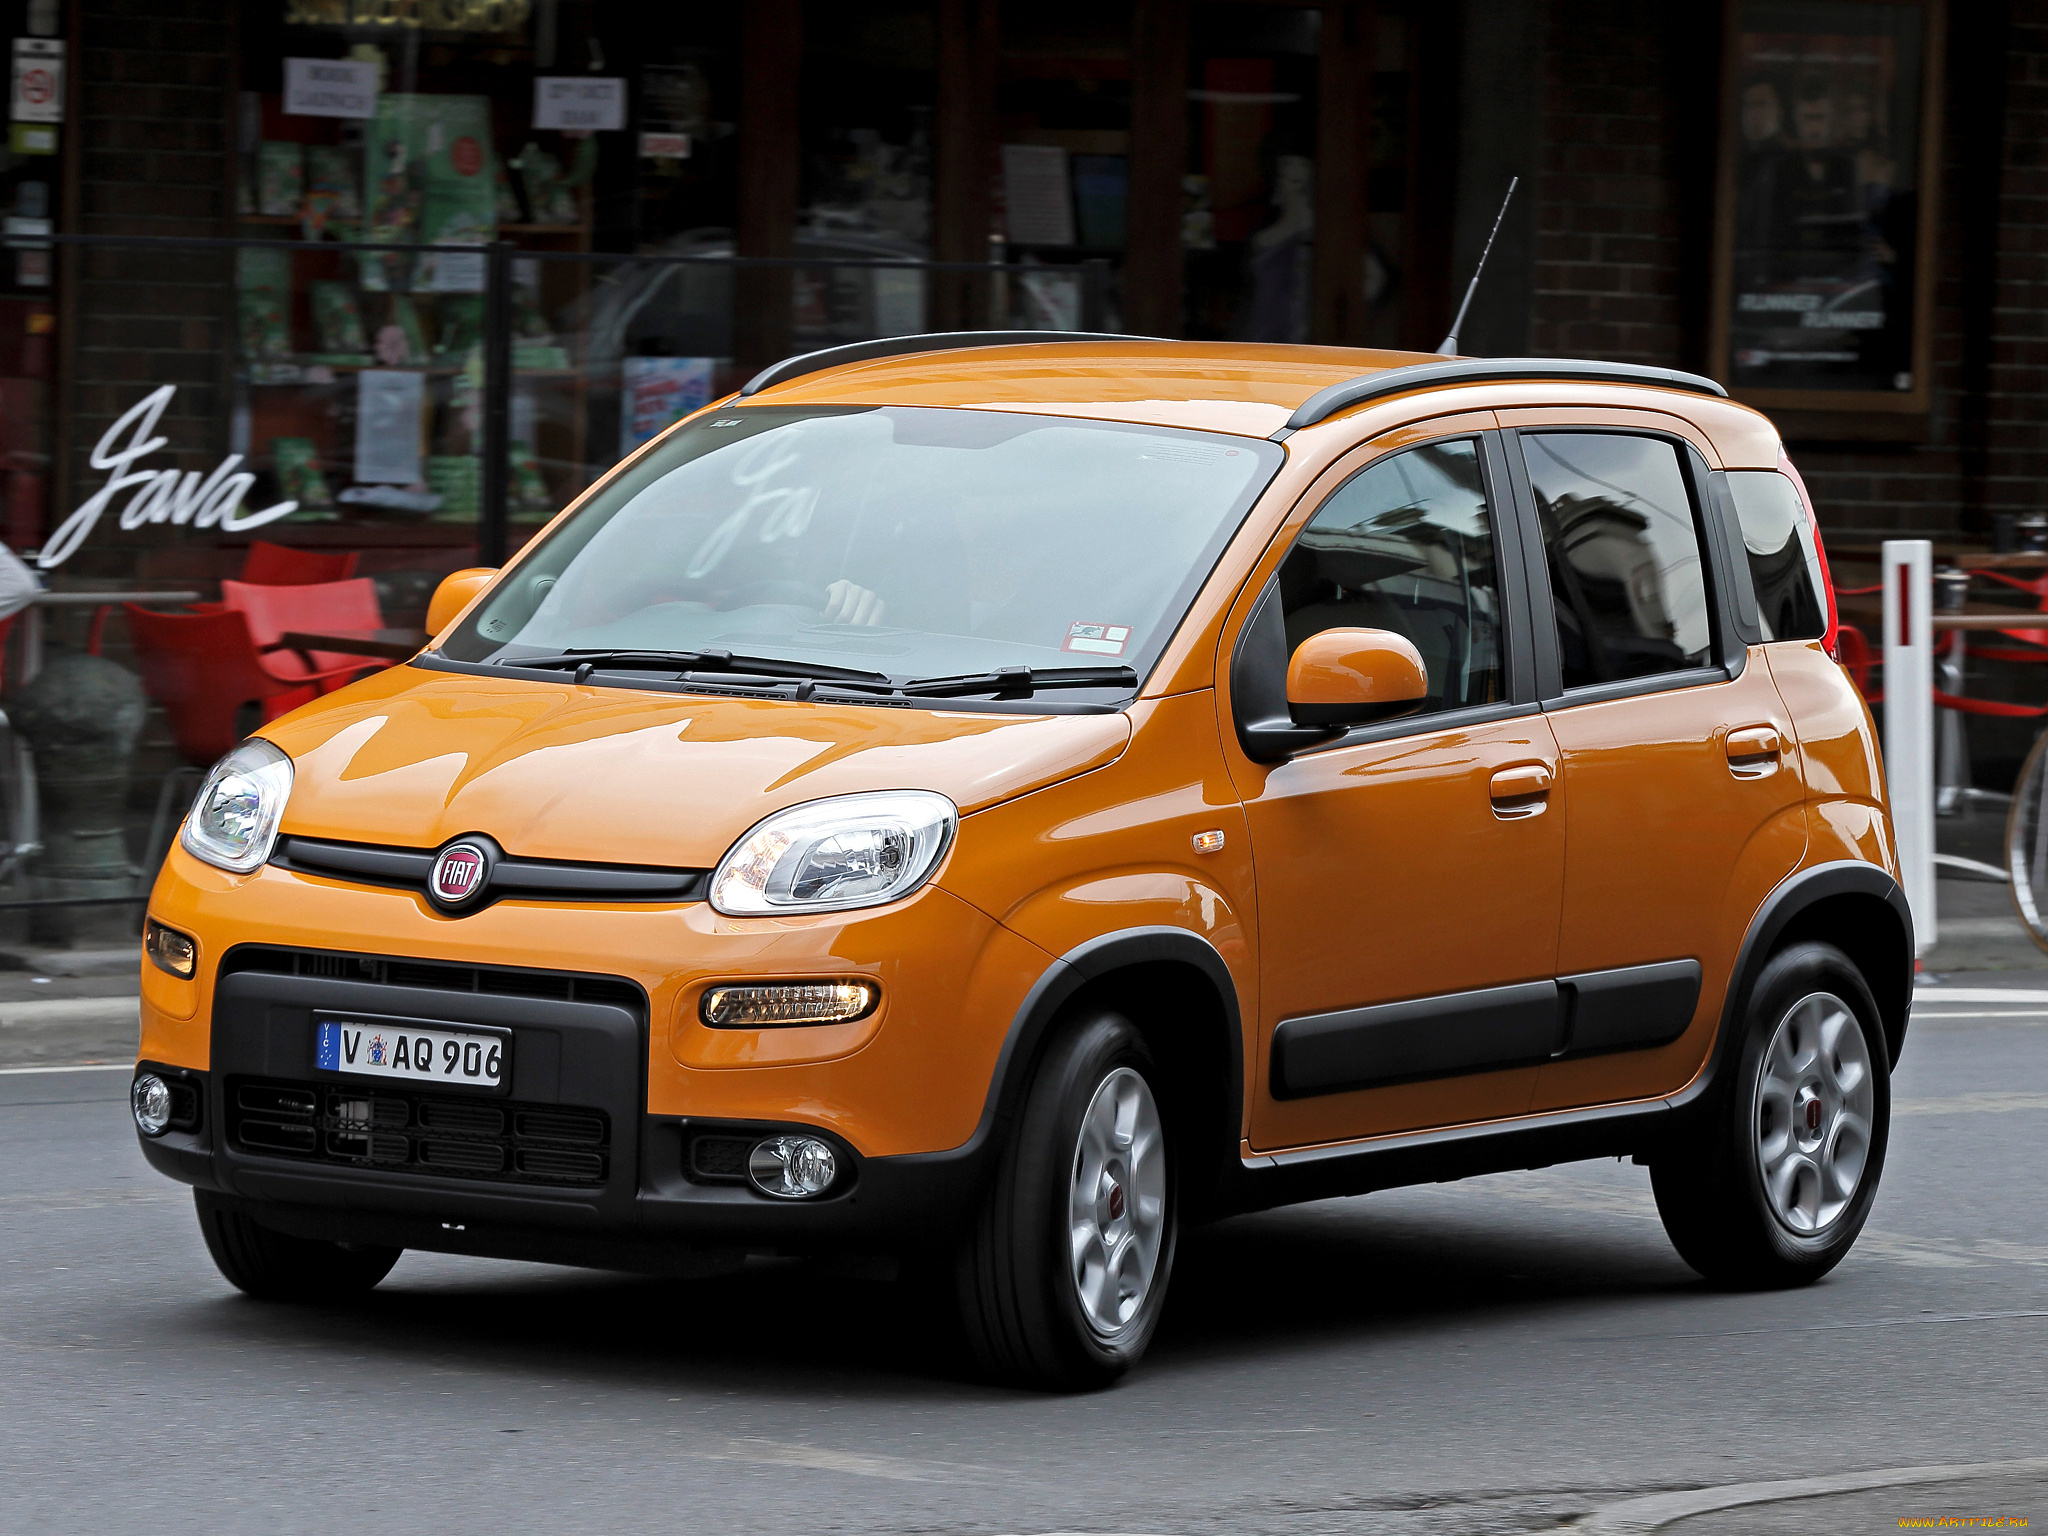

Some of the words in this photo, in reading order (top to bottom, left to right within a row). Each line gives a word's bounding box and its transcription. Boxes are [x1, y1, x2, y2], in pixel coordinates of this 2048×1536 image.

[37, 384, 299, 568] Java
[441, 860, 475, 887] FIAT
[323, 1023, 331, 1047] VIC
[442, 1041, 501, 1078] 906
